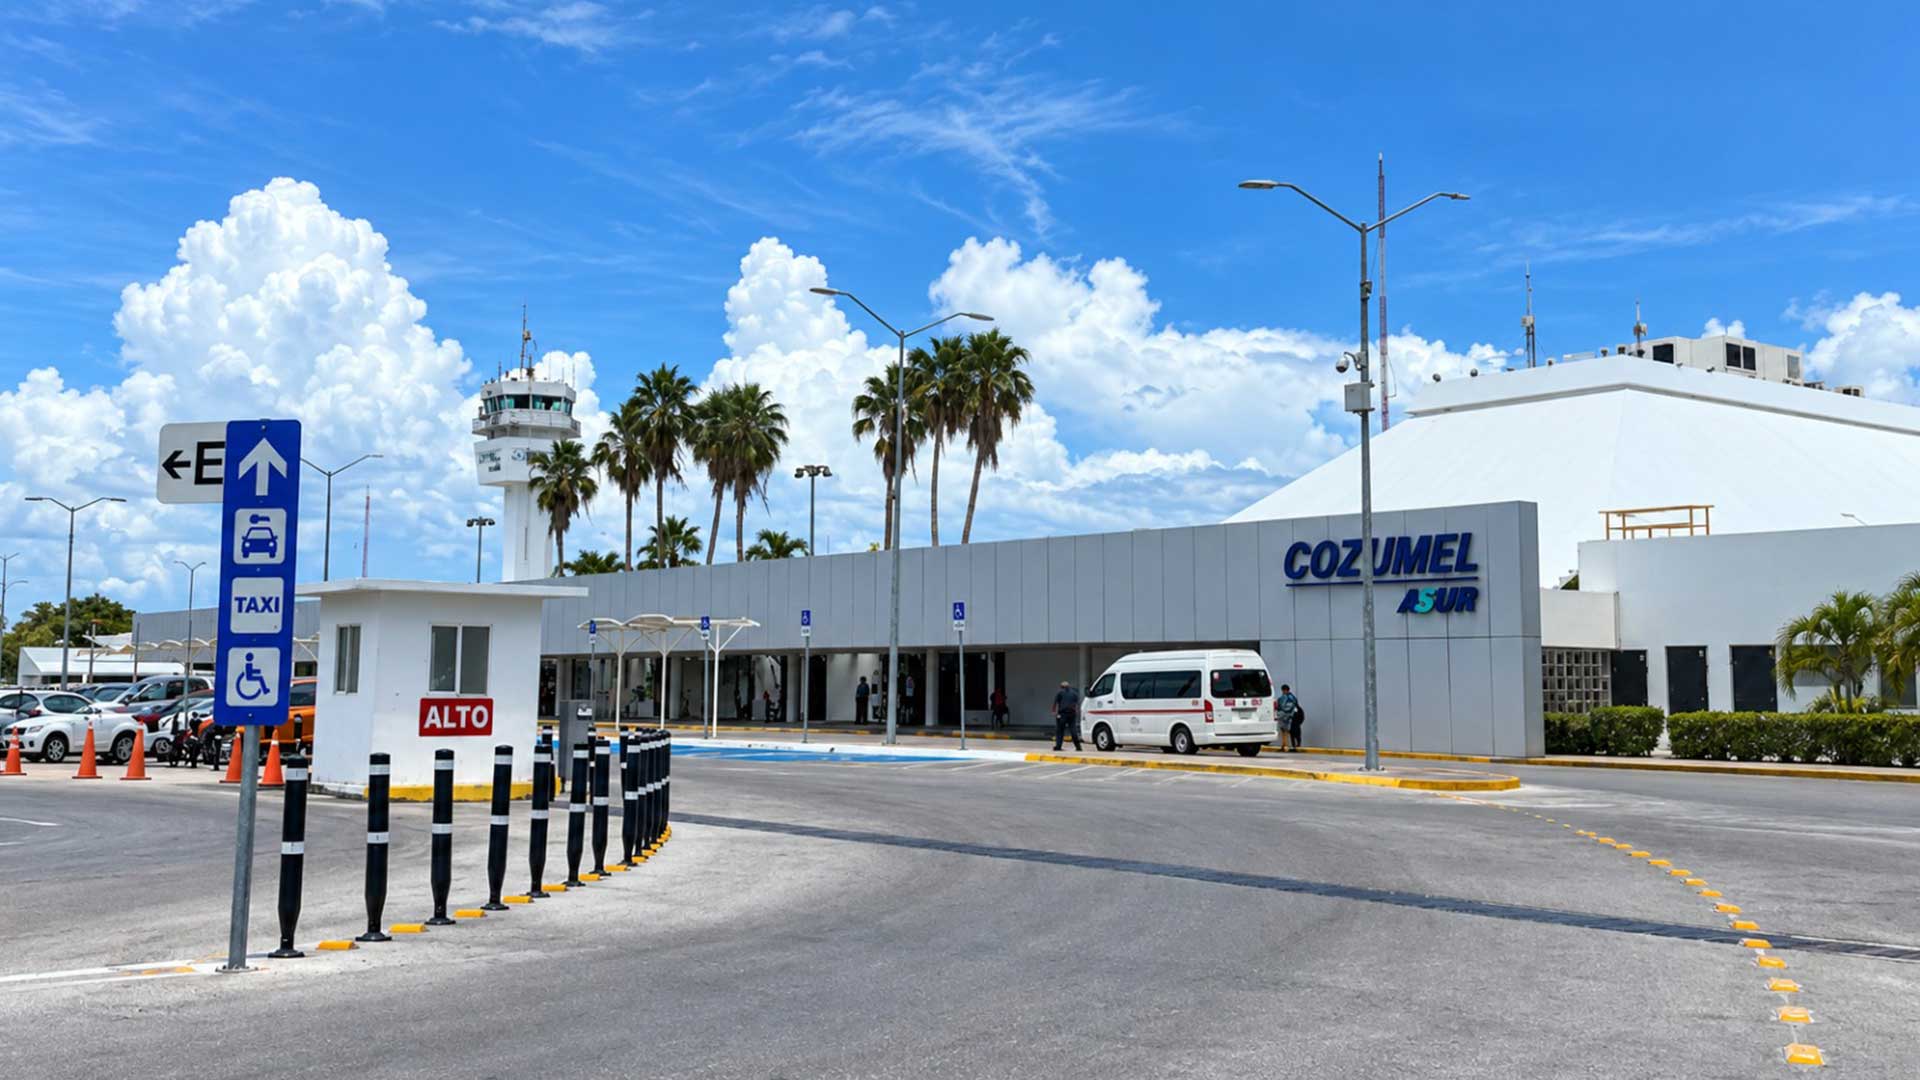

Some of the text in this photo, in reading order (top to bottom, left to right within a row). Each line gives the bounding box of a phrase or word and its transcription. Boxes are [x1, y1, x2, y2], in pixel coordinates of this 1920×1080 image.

[194, 441, 226, 485] E
[1284, 532, 1478, 580] COZUMEL
[234, 596, 280, 614] TAXI
[1396, 586, 1479, 614] ASUR
[423, 705, 489, 729] ALTO
